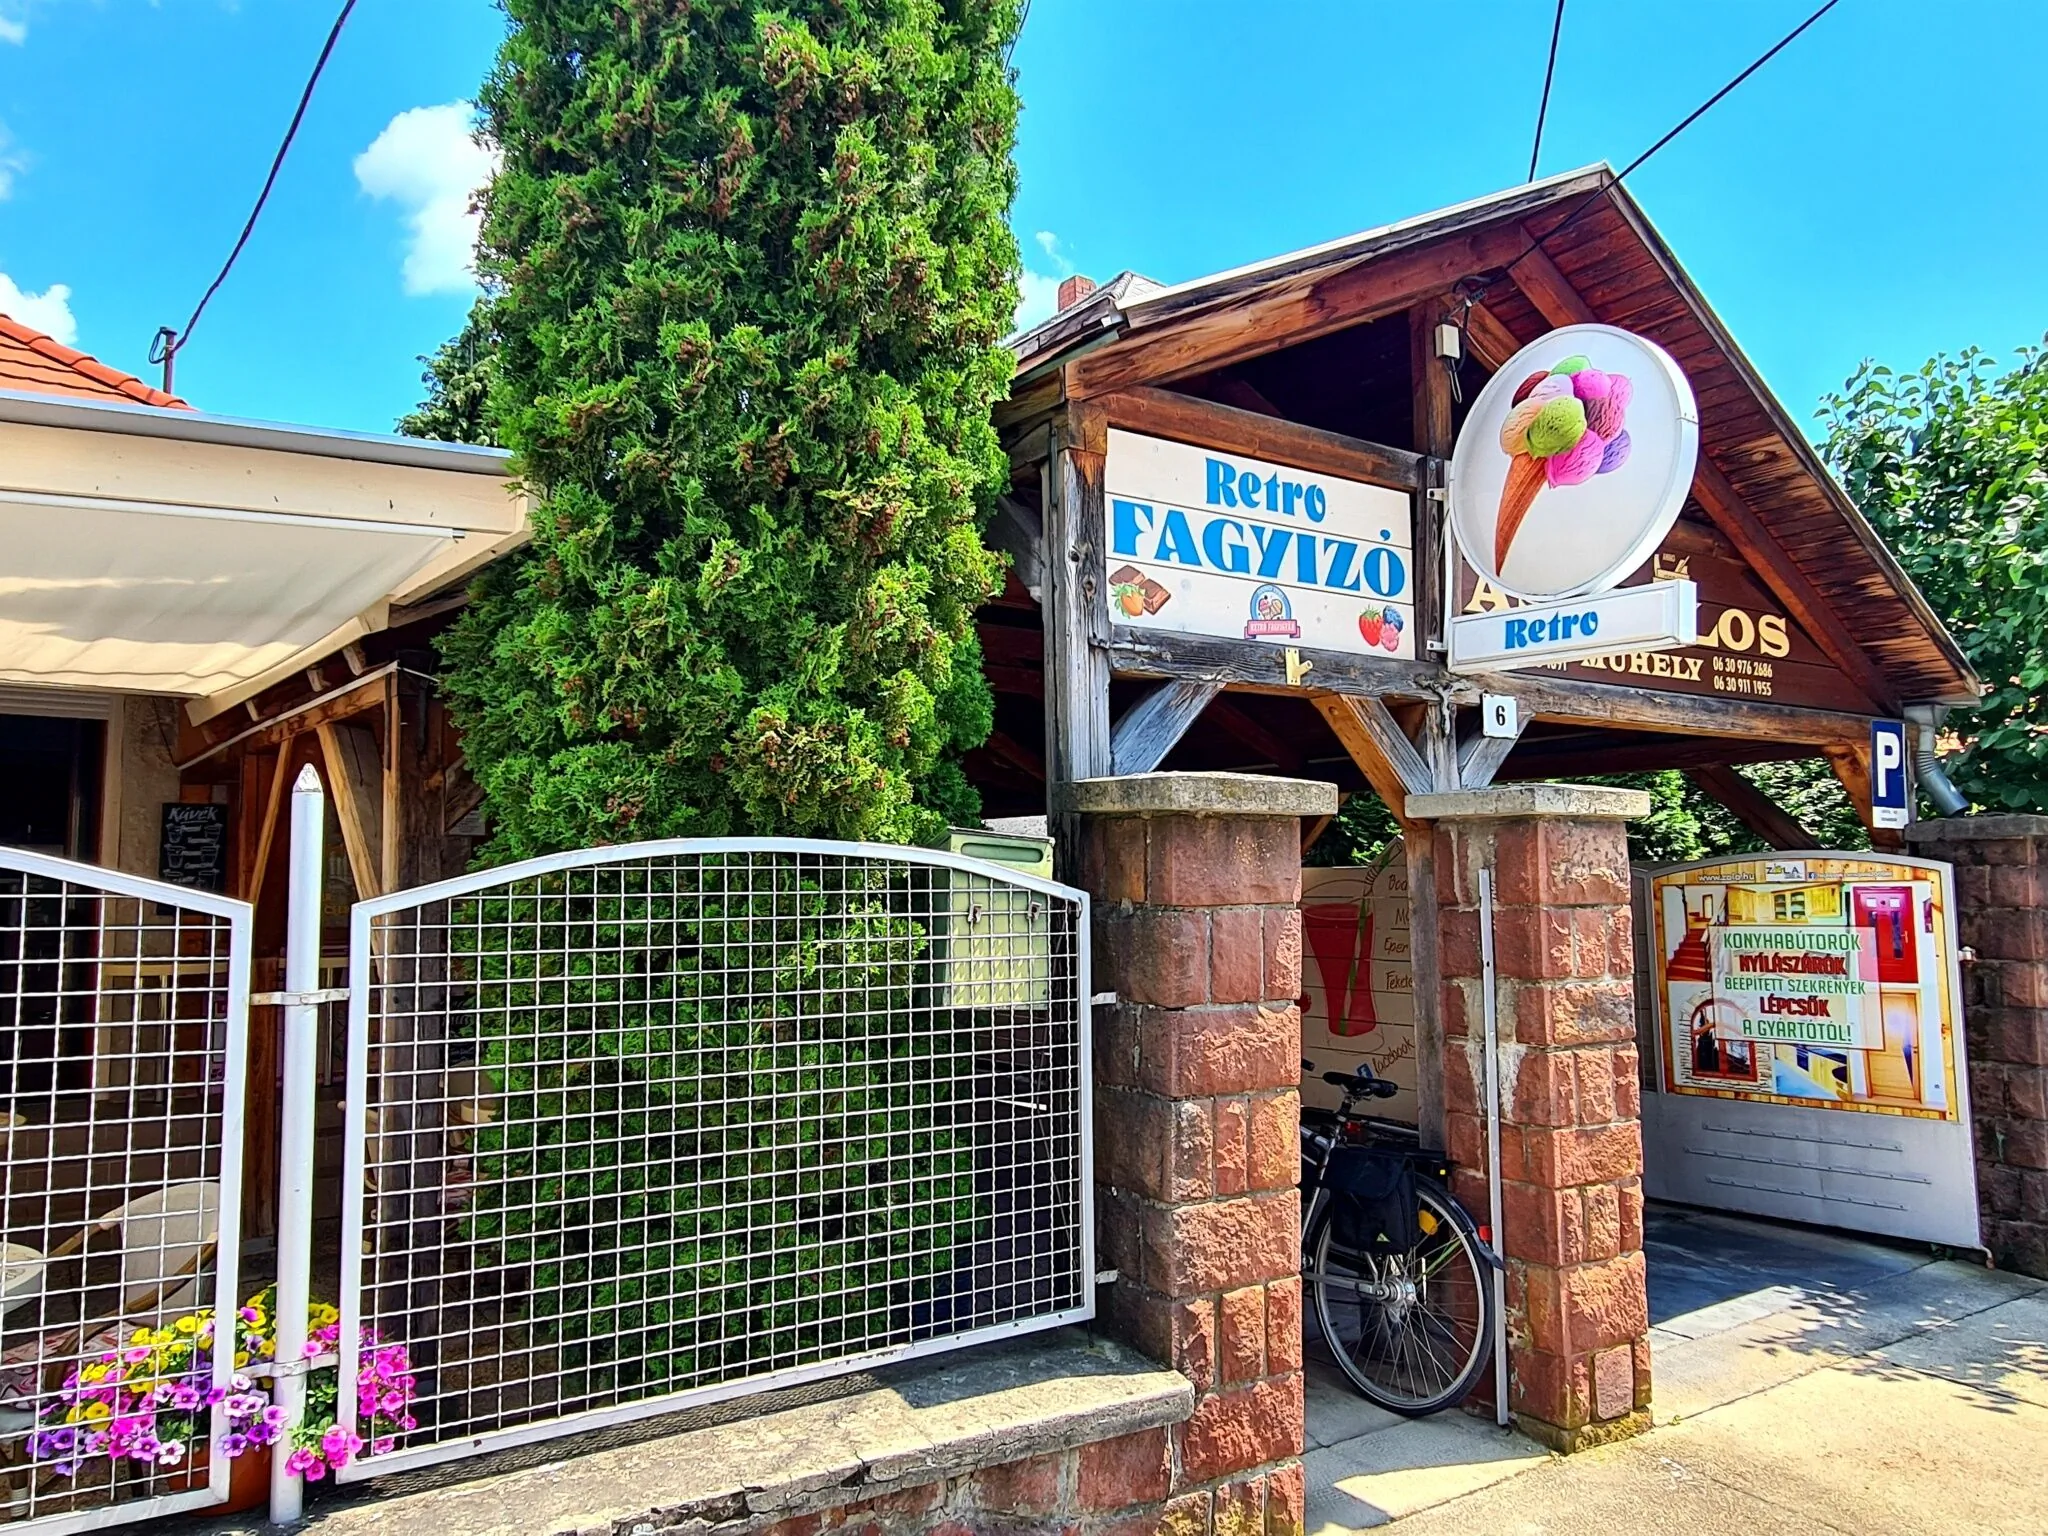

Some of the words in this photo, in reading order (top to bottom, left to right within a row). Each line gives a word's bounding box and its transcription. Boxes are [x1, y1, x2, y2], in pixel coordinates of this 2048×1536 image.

[1205, 457, 1326, 523] Retro
[1112, 499, 1405, 598] FAGYIZÓ
[1505, 611, 1598, 649] Retro
[1713, 656, 1724, 671] 06
[1725, 658, 1736, 673] 30
[1737, 660, 1752, 675] 976
[1753, 662, 1773, 678] 2686
[1714, 675, 1725, 690] 06
[1726, 677, 1737, 692] 30
[1738, 679, 1751, 694] 911
[1753, 680, 1772, 696] 1955
[1495, 705, 1506, 727] 6
[1876, 731, 1900, 798] P
[1384, 937, 1409, 956] Eper
[1723, 930, 1861, 950] KONYHABÚTOROK
[1739, 952, 1848, 975] NYÍLÁSZÁRÓK
[1724, 976, 1784, 992] BEÉPÍTETT
[1788, 978, 1866, 995] SZEKRÉNYEK
[1759, 993, 1832, 1018] LÉPCSŐK
[1742, 1019, 1751, 1035] A
[1757, 1018, 1852, 1042] GYÁRTÓTÓL!
[1372, 1036, 1415, 1078] facebook
